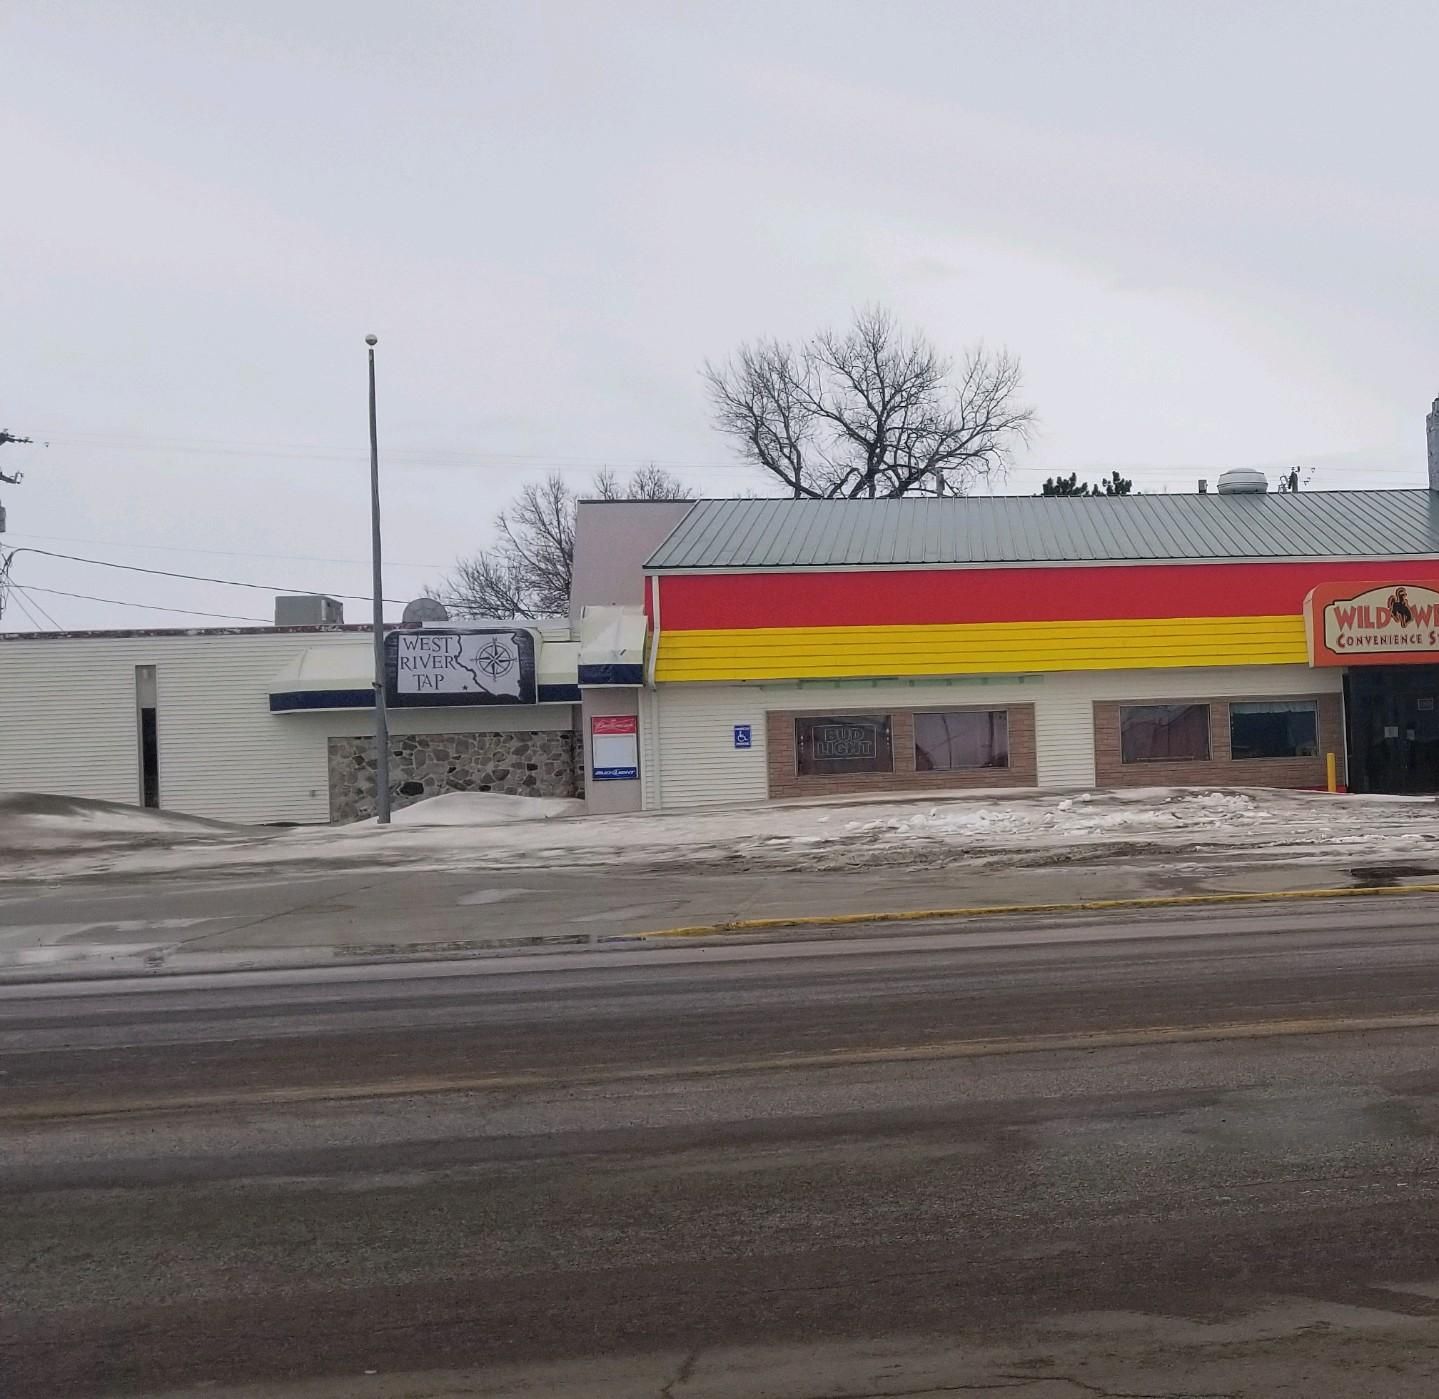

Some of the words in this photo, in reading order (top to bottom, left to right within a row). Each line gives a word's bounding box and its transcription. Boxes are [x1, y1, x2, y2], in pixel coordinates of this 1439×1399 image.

[1334, 604, 1391, 631] WILD
[403, 636, 453, 653] WEST
[1337, 633, 1423, 648] CONVENIENCE
[400, 654, 457, 671] RIVER
[412, 674, 445, 691] TAP
[824, 727, 865, 742] BUD
